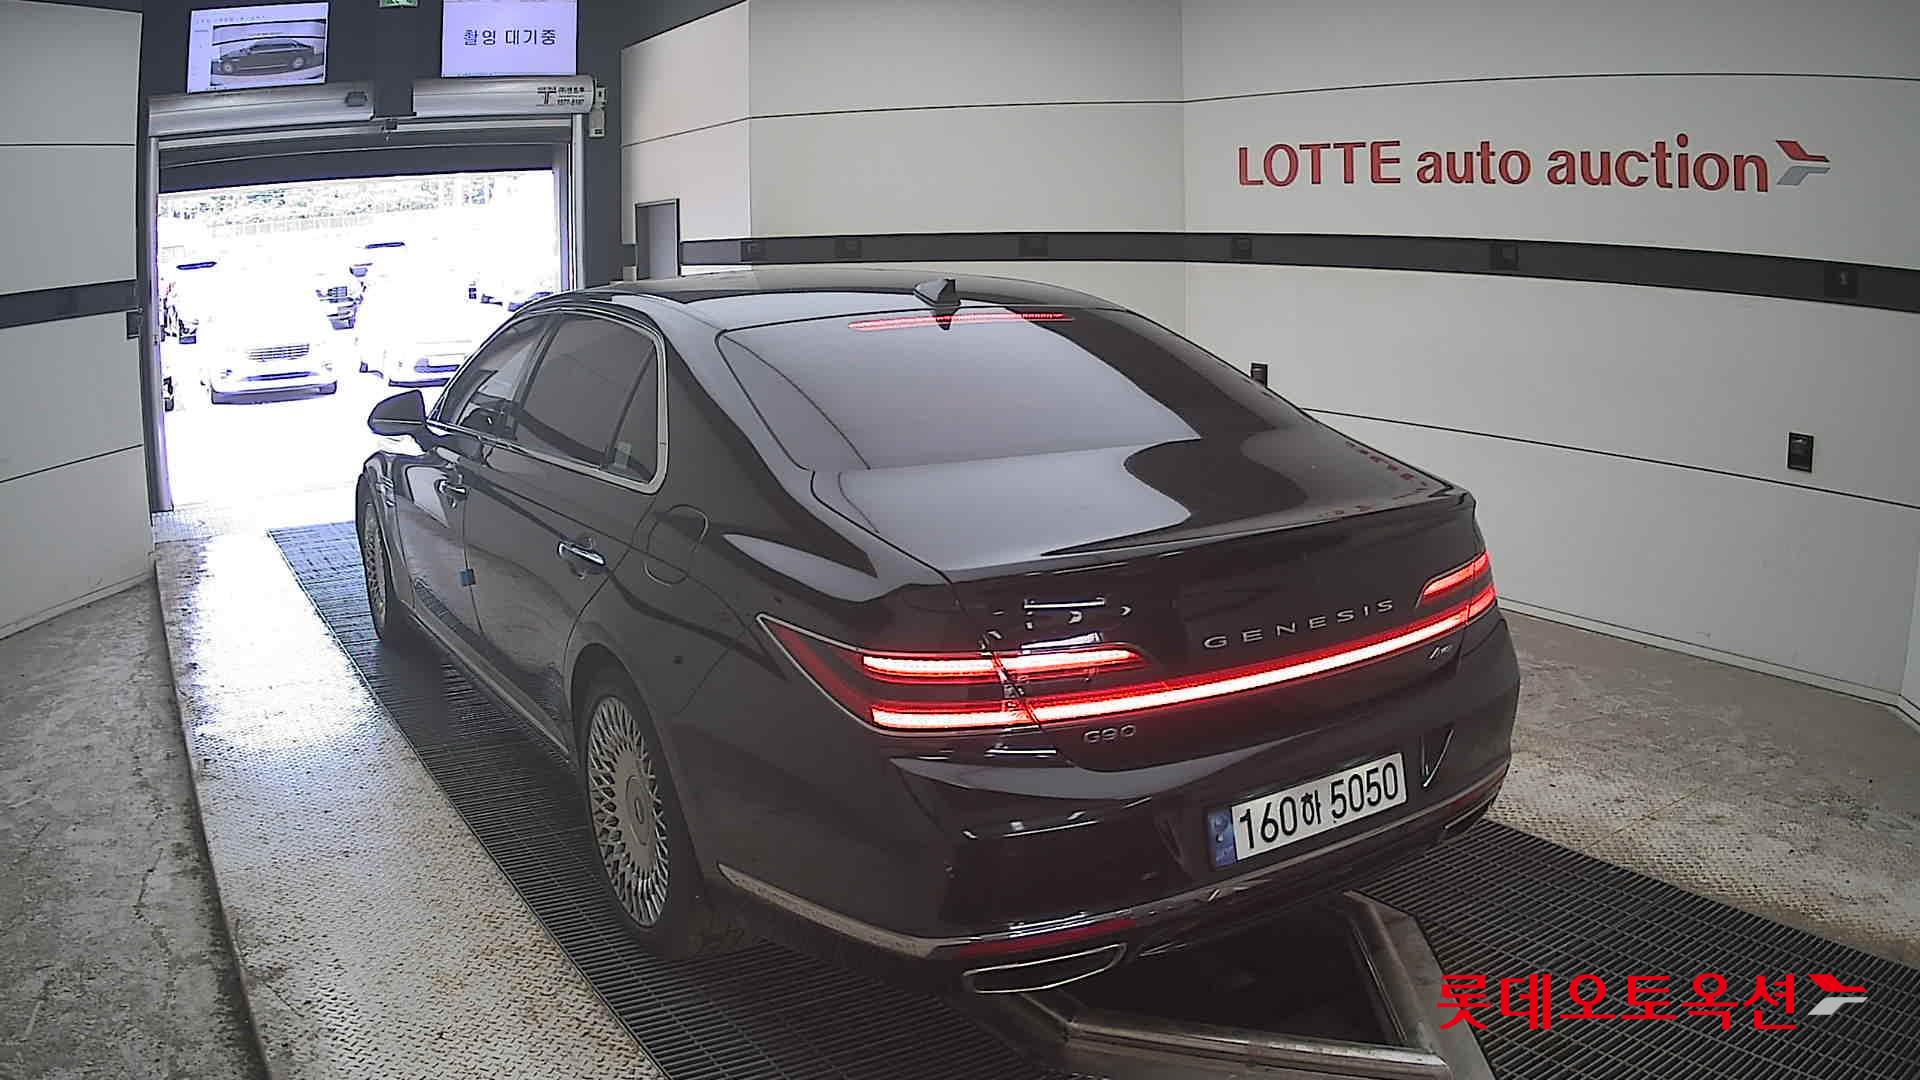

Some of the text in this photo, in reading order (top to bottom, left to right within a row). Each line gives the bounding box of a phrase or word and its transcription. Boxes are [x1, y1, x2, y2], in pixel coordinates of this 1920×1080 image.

[464, 29, 557, 46] 촬영 대기중
[1238, 133, 1769, 193] LOTTE auto auction
[1203, 599, 1394, 649] GENESIS
[1083, 724, 1137, 744] G90
[1239, 761, 1398, 850] 160하 5050
